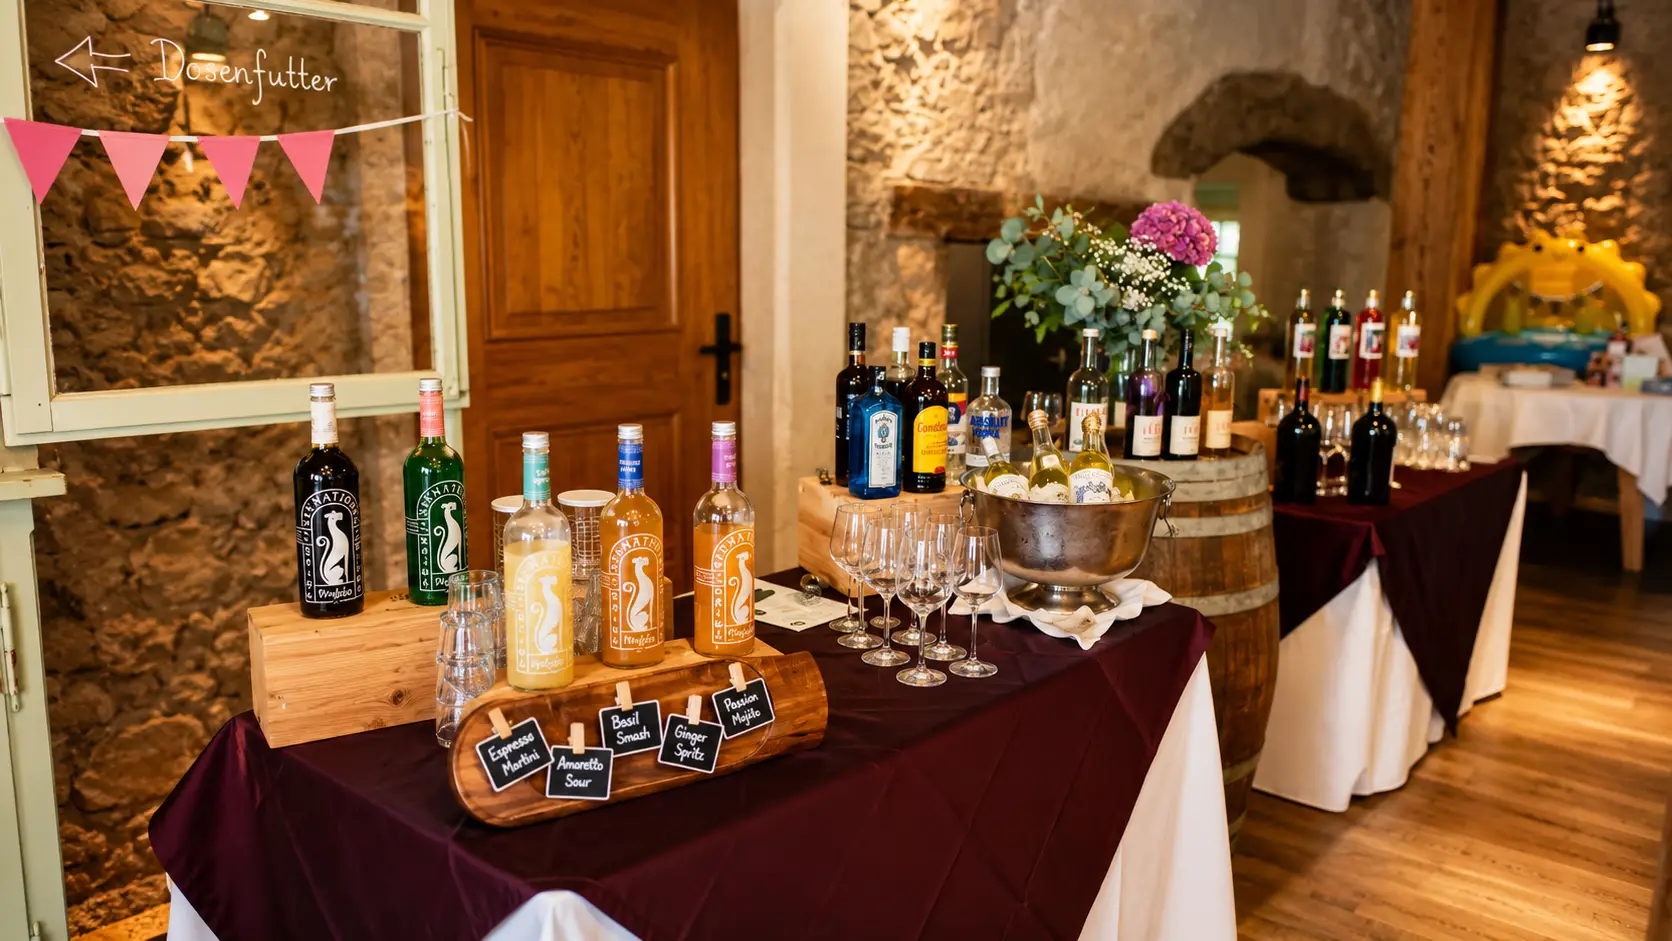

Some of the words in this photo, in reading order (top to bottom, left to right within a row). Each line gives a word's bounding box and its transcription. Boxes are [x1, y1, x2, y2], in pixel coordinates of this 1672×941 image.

[150, 38, 337, 106] Dosenfutter
[724, 693, 759, 713] Passion
[611, 711, 640, 730] Basil
[732, 708, 761, 726] Mojito
[616, 726, 651, 745] Smash
[674, 725, 708, 746] Ginger
[488, 732, 535, 763] Espresso
[674, 743, 705, 762] Spritz
[502, 749, 540, 776] Martini
[565, 773, 592, 787] Sour
